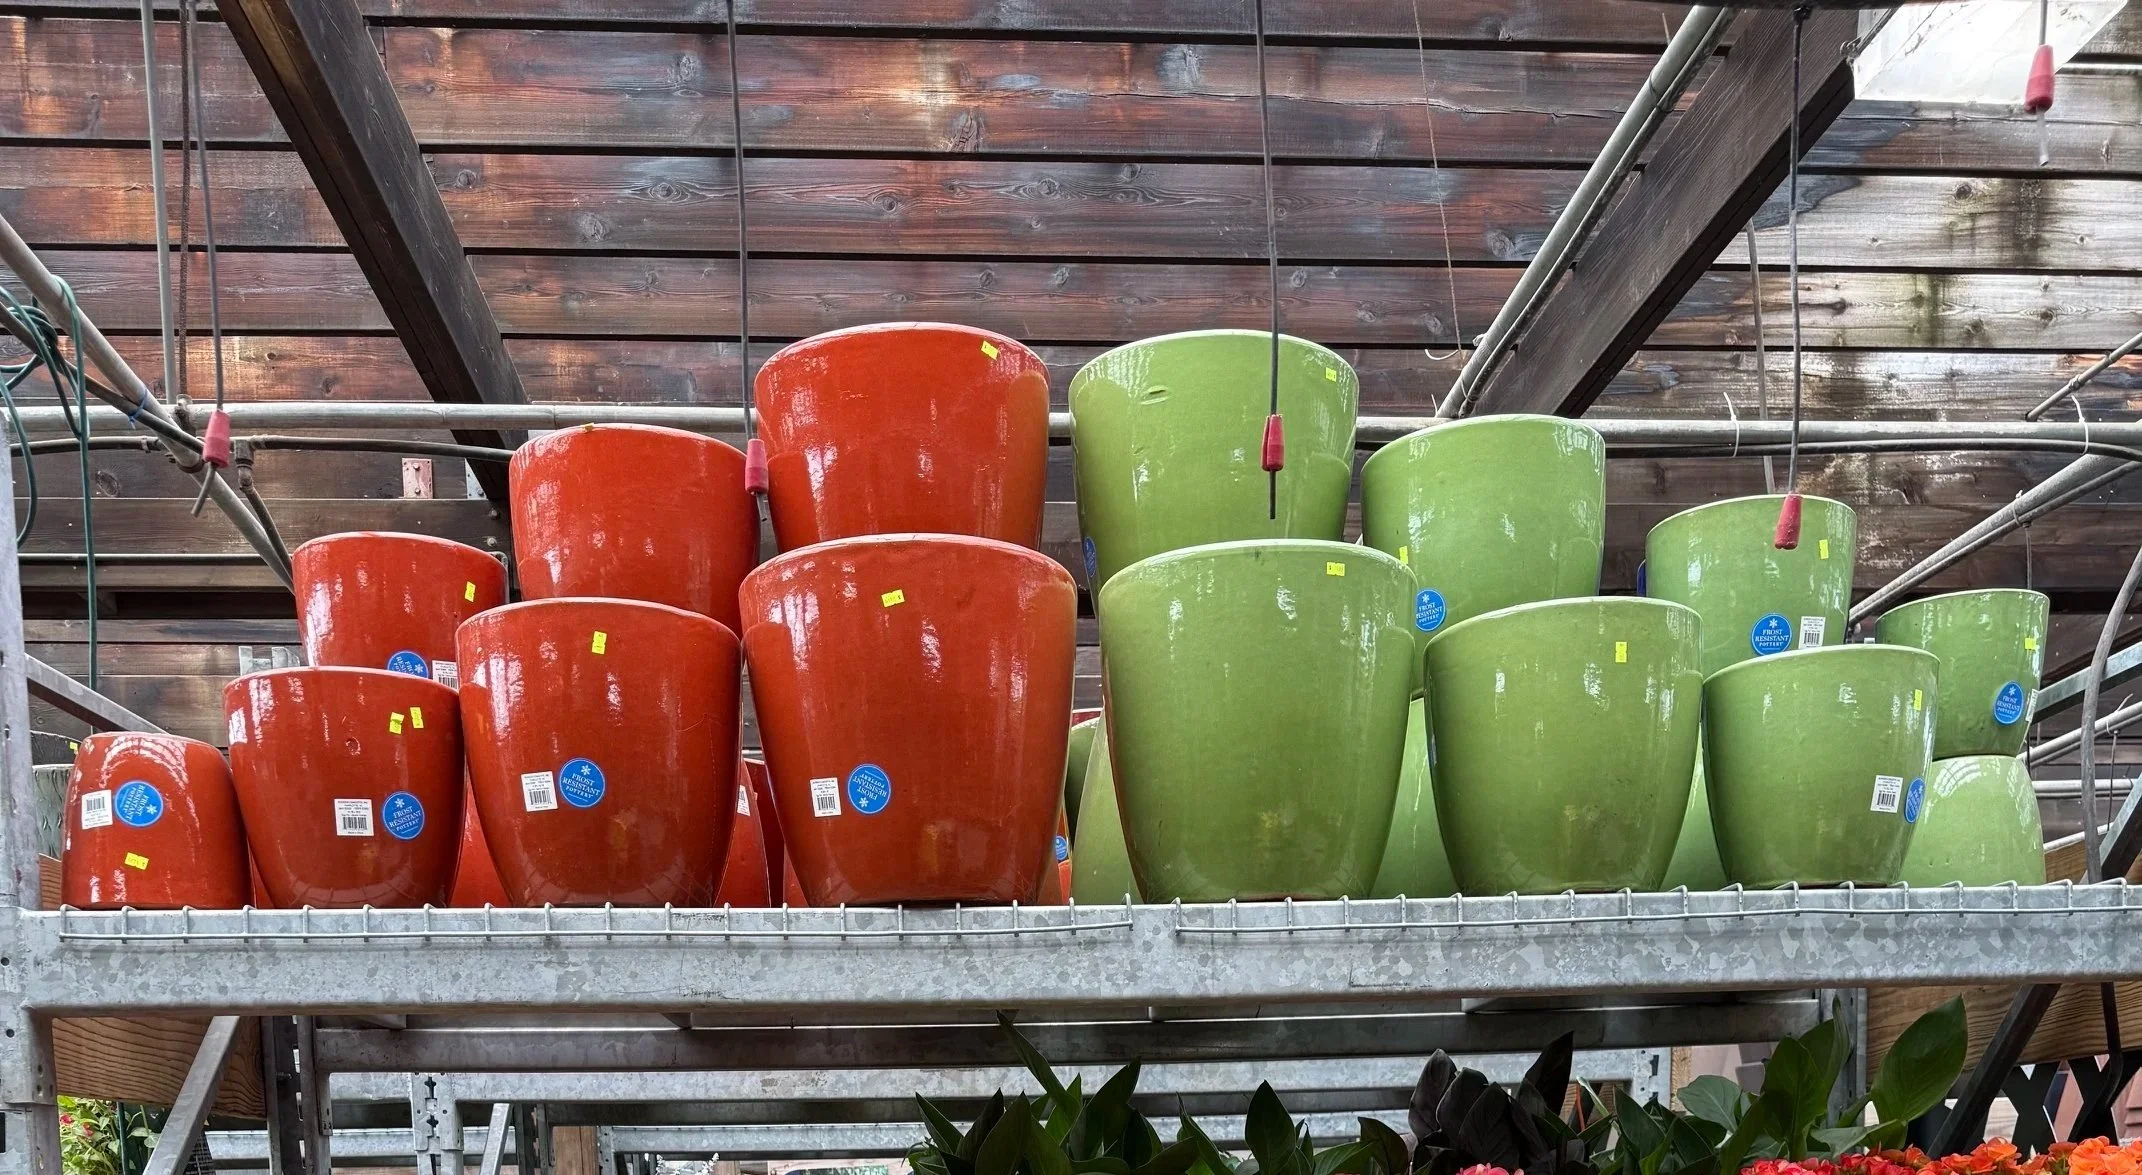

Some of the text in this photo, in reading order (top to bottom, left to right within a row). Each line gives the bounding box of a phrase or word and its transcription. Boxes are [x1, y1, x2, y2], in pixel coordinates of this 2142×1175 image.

[1419, 602, 1435, 611] FROST
[562, 777, 601, 796] RESISTANT
[572, 773, 595, 786] FROST
[852, 776, 888, 798] RESISTANT
[860, 773, 885, 788] POTTERY
[565, 786, 593, 799] POTTERY
[857, 786, 878, 801] FROST
[123, 787, 138, 815] POTTERY
[126, 784, 146, 820] RESISTANT
[135, 795, 150, 816] FROST
[389, 810, 421, 828] RESISTANT
[393, 806, 413, 819] FROST
[396, 818, 420, 831] POTTERY
